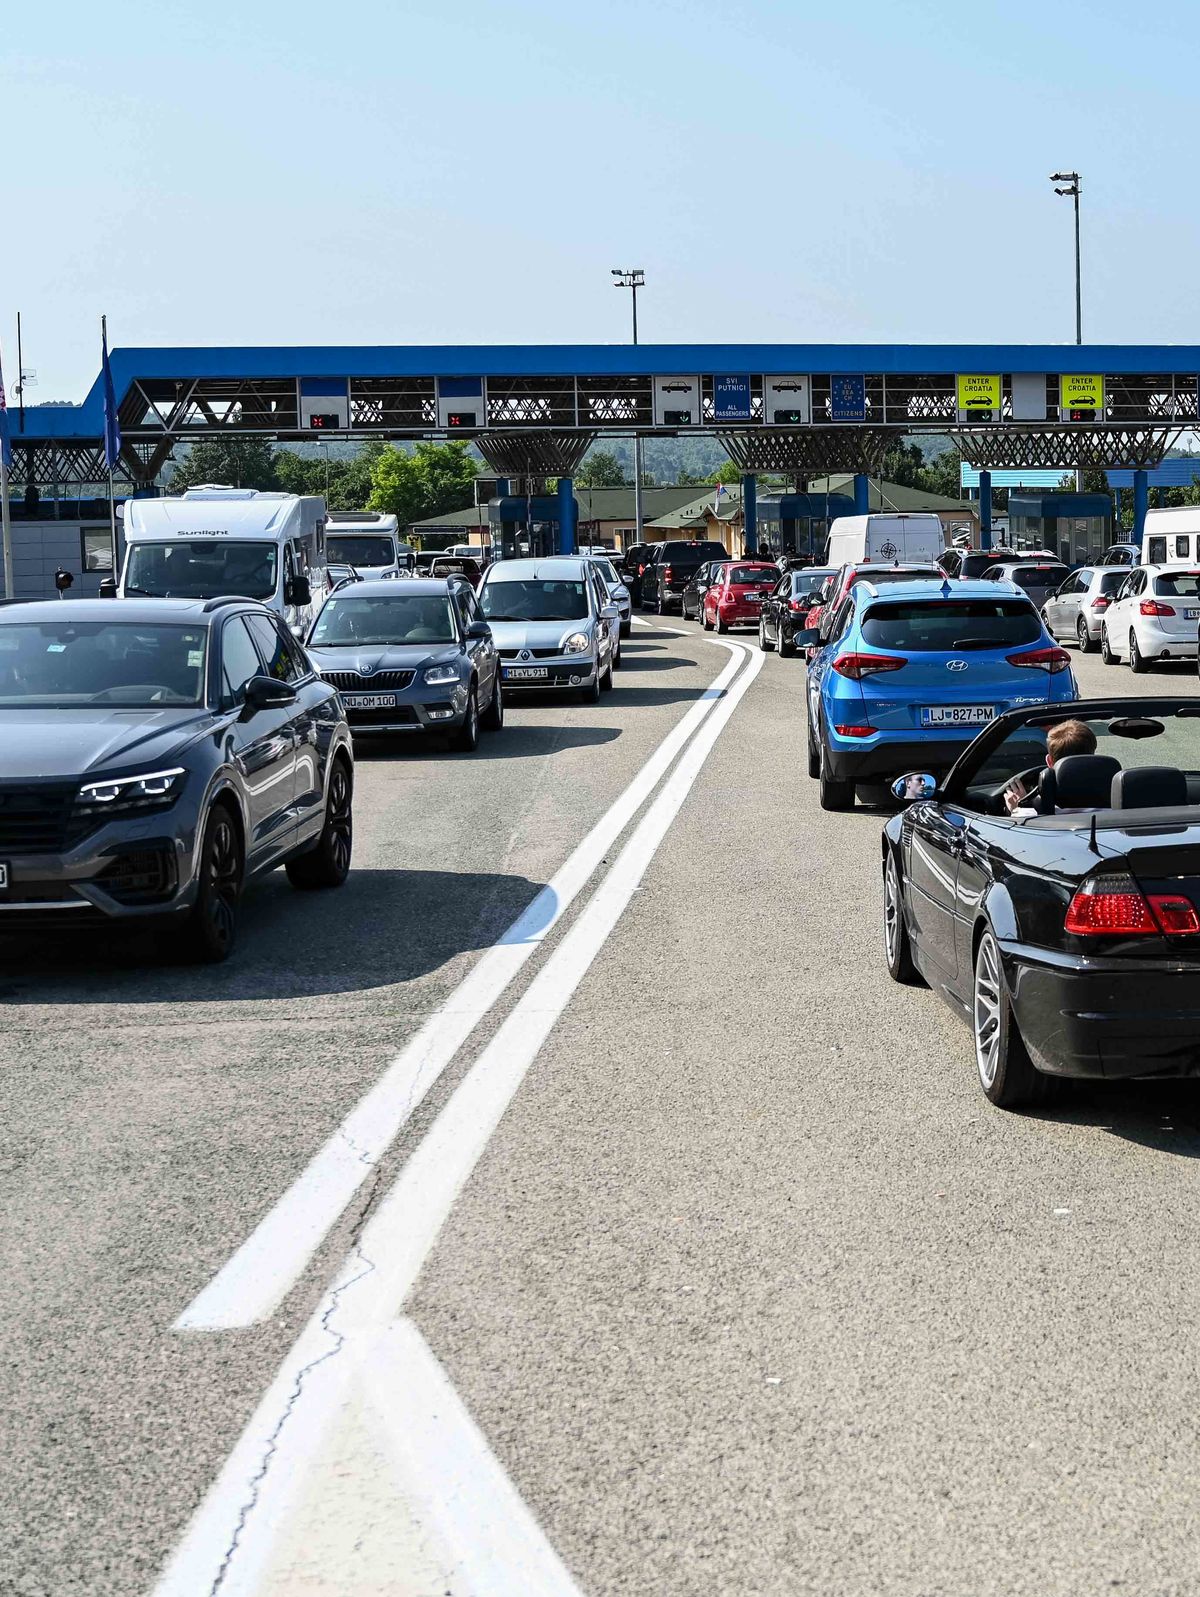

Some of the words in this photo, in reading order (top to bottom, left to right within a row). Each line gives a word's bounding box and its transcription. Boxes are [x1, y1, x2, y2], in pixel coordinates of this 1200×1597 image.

[522, 669, 532, 677] YL
[533, 668, 547, 677] 911
[344, 697, 357, 707] NU
[362, 697, 375, 706] OM
[377, 696, 395, 706] 100
[931, 709, 945, 721] LJ
[952, 708, 993, 721] 827-PM
